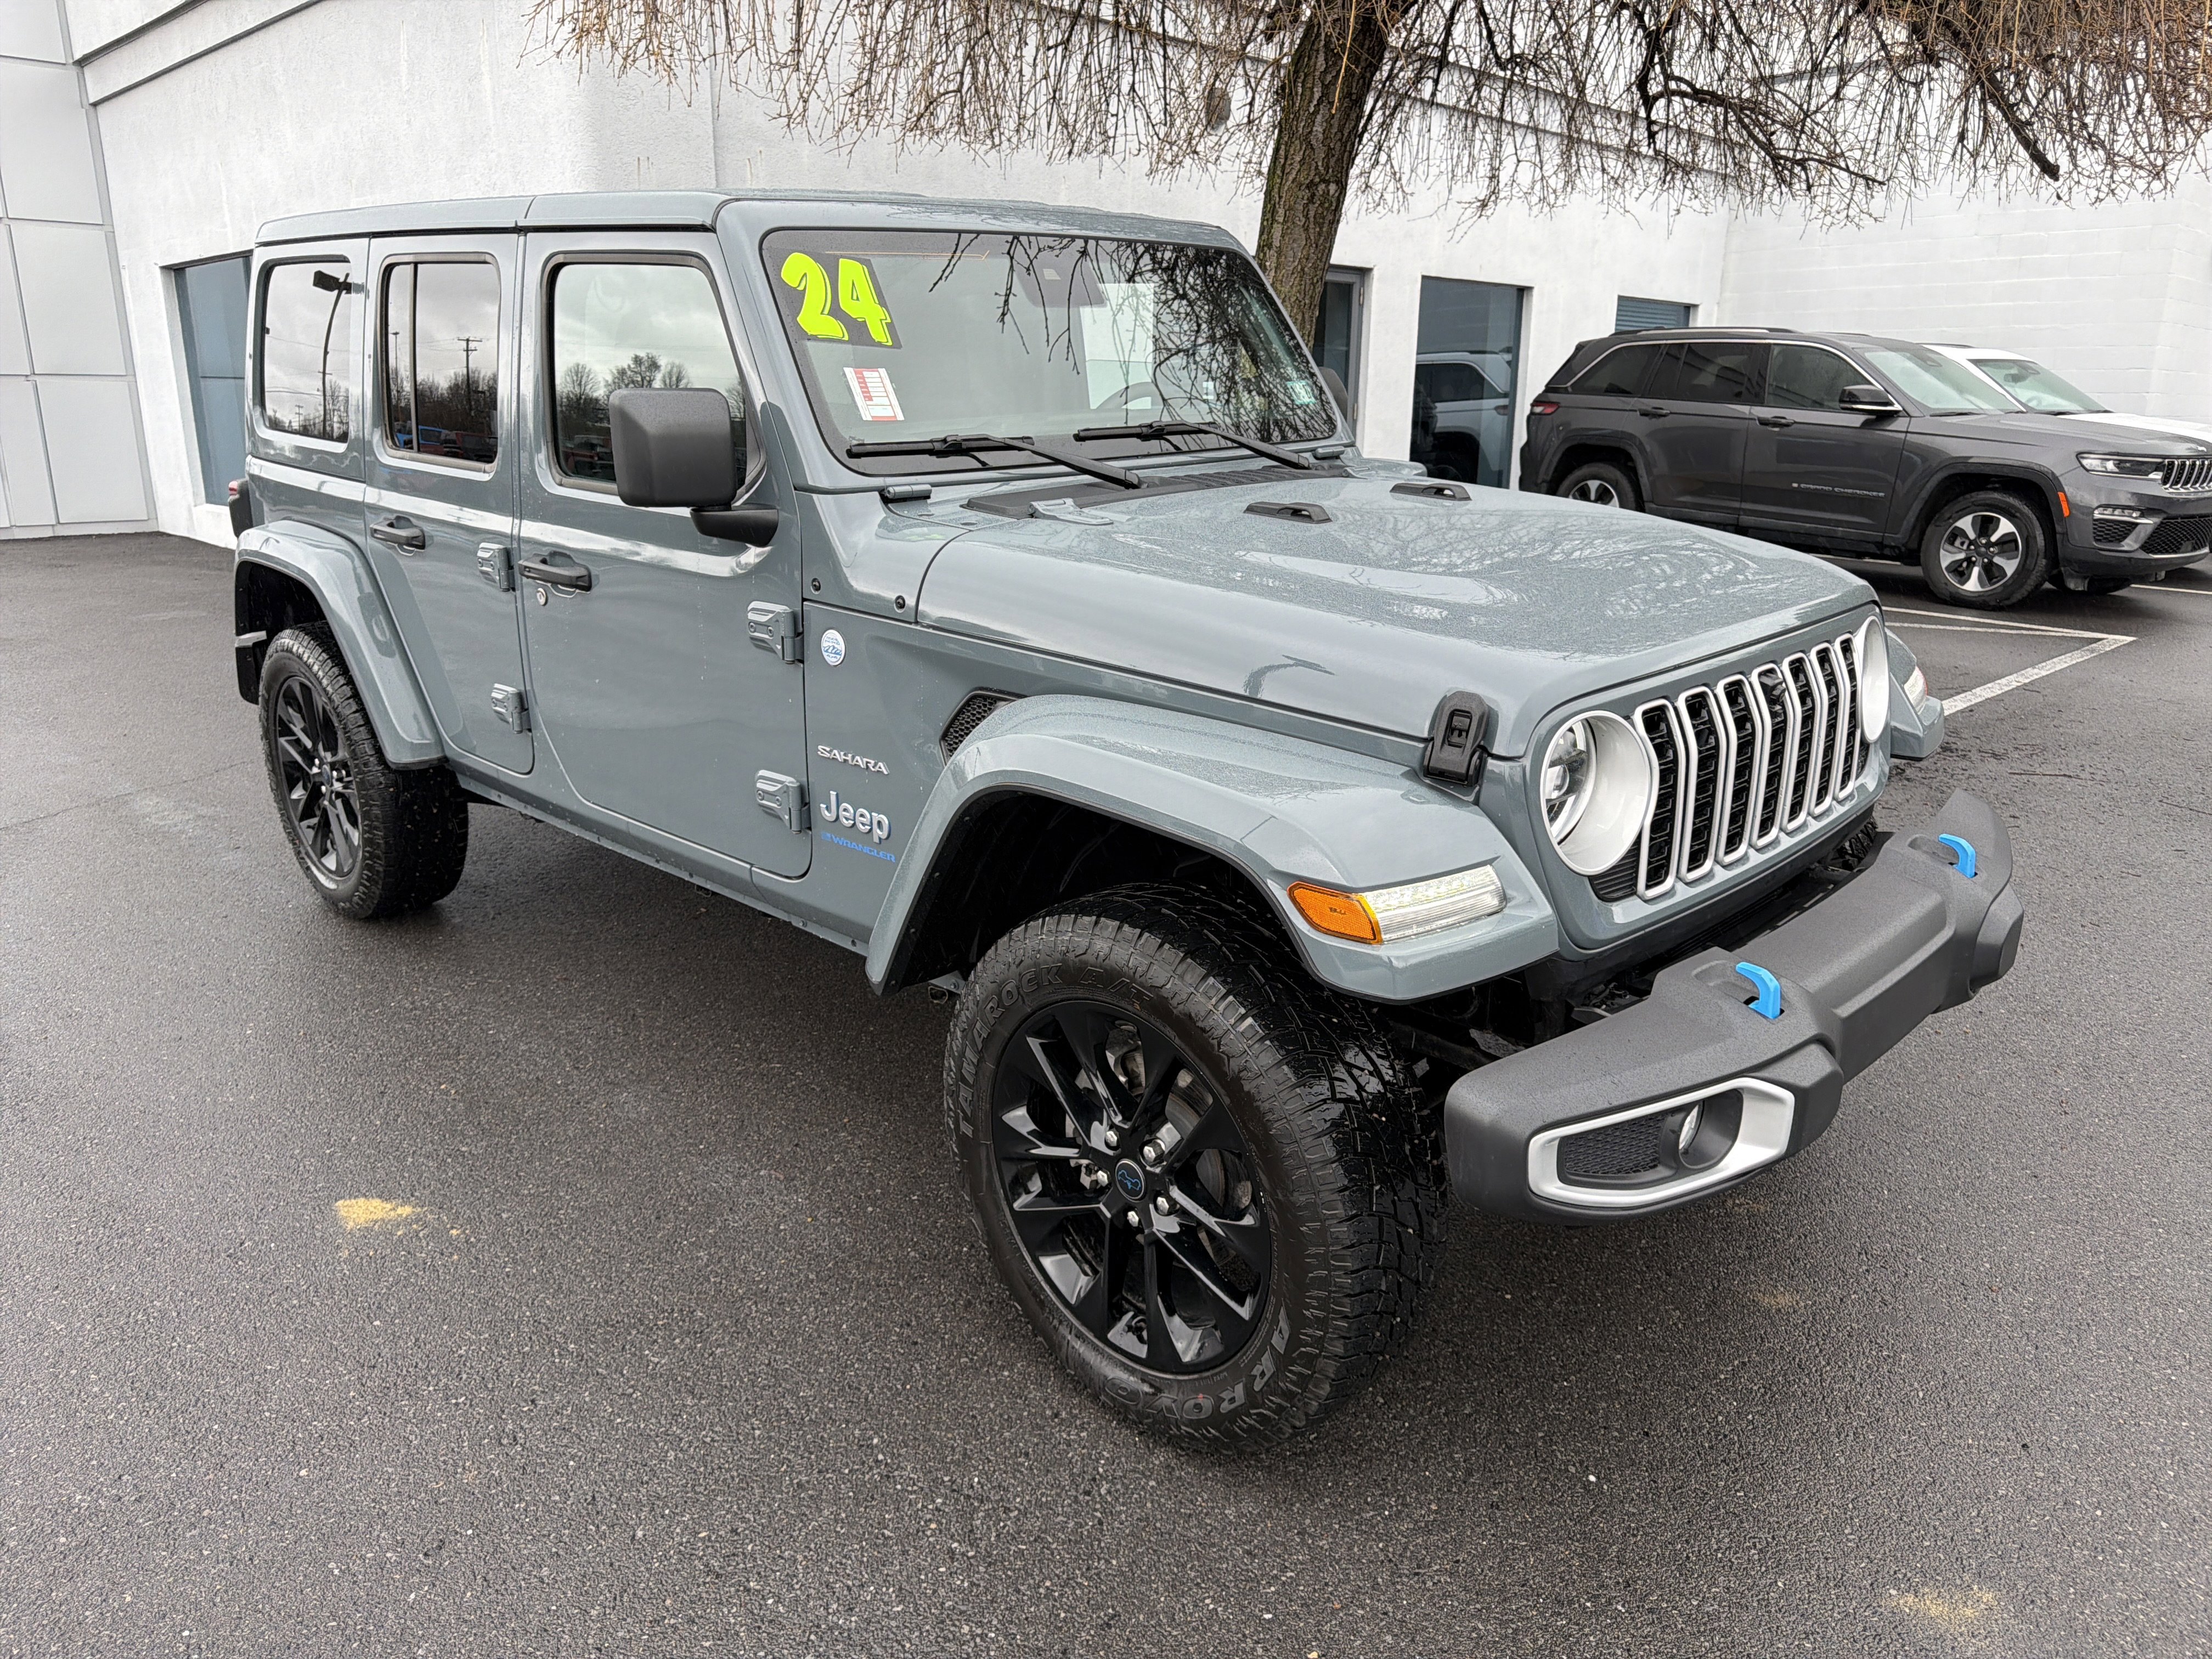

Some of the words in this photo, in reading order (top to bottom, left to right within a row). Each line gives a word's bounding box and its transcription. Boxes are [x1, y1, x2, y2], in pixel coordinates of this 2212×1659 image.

[781, 252, 893, 346] 24
[817, 745, 889, 775] SAHARA
[820, 791, 891, 844] Jeep
[832, 834, 896, 863] WRANGLER
